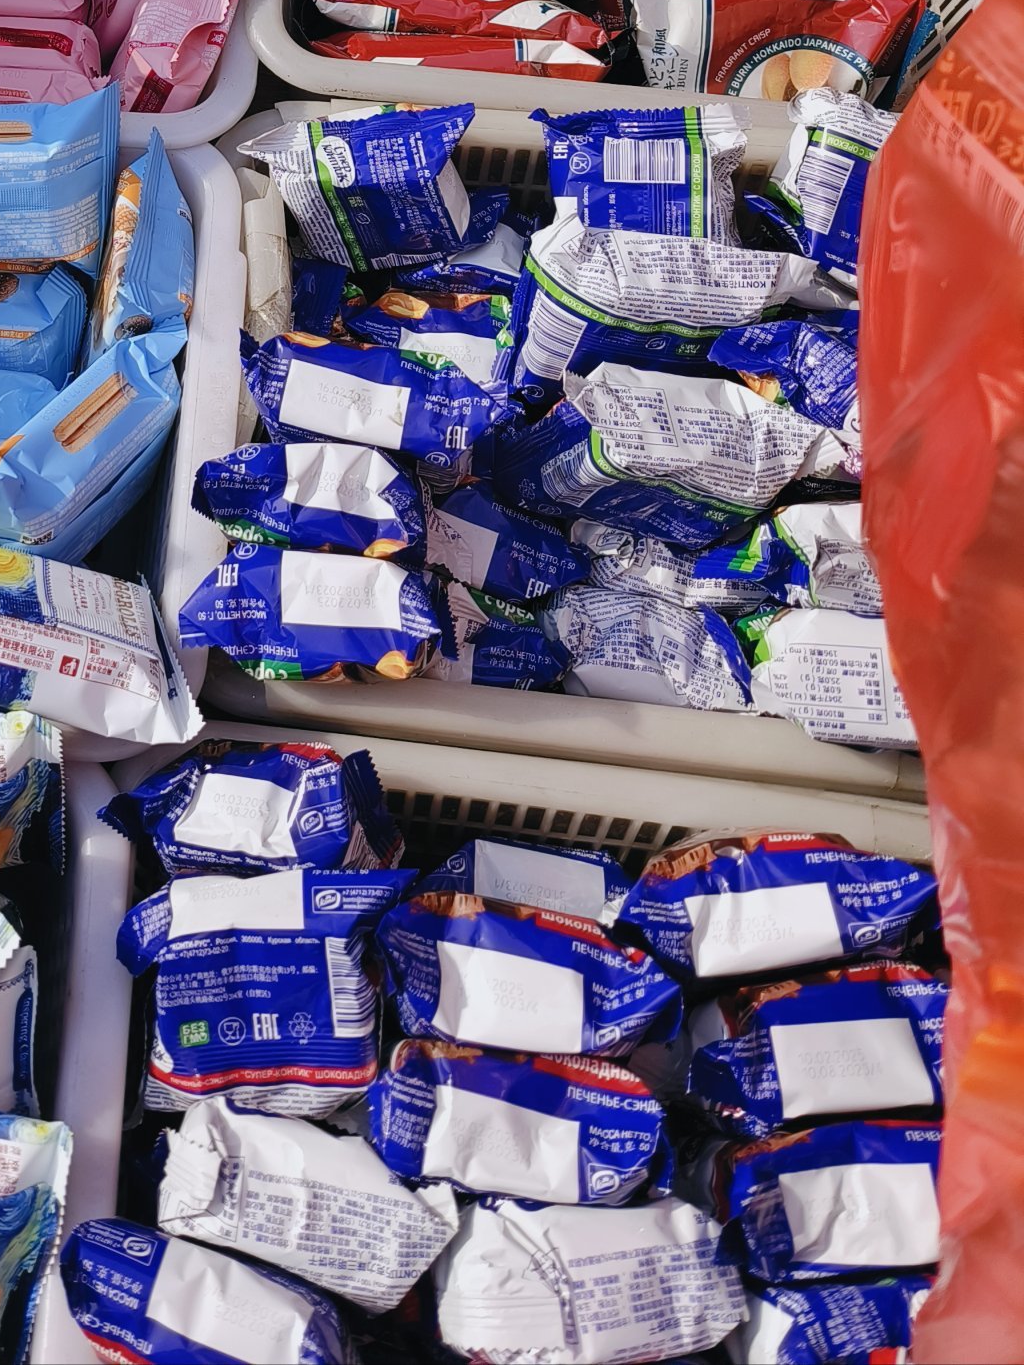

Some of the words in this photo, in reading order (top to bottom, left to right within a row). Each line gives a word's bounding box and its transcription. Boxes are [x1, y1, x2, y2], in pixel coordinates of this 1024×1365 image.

[715, 42, 748, 83] FRAGRANT
[747, 27, 772, 47] CRISP
[733, 65, 753, 88] BURN
[753, 37, 803, 63] HOKKAIDO
[802, 37, 855, 63] JAPANESE
[425, 393, 449, 407] МАССА
[446, 425, 470, 451] EAC
[217, 563, 239, 588] EAC
[836, 882, 870, 894] МАССА
[181, 1021, 206, 1035] БЕЗ
[252, 1012, 282, 1042] EAC
[589, 1125, 619, 1140] МАССА
